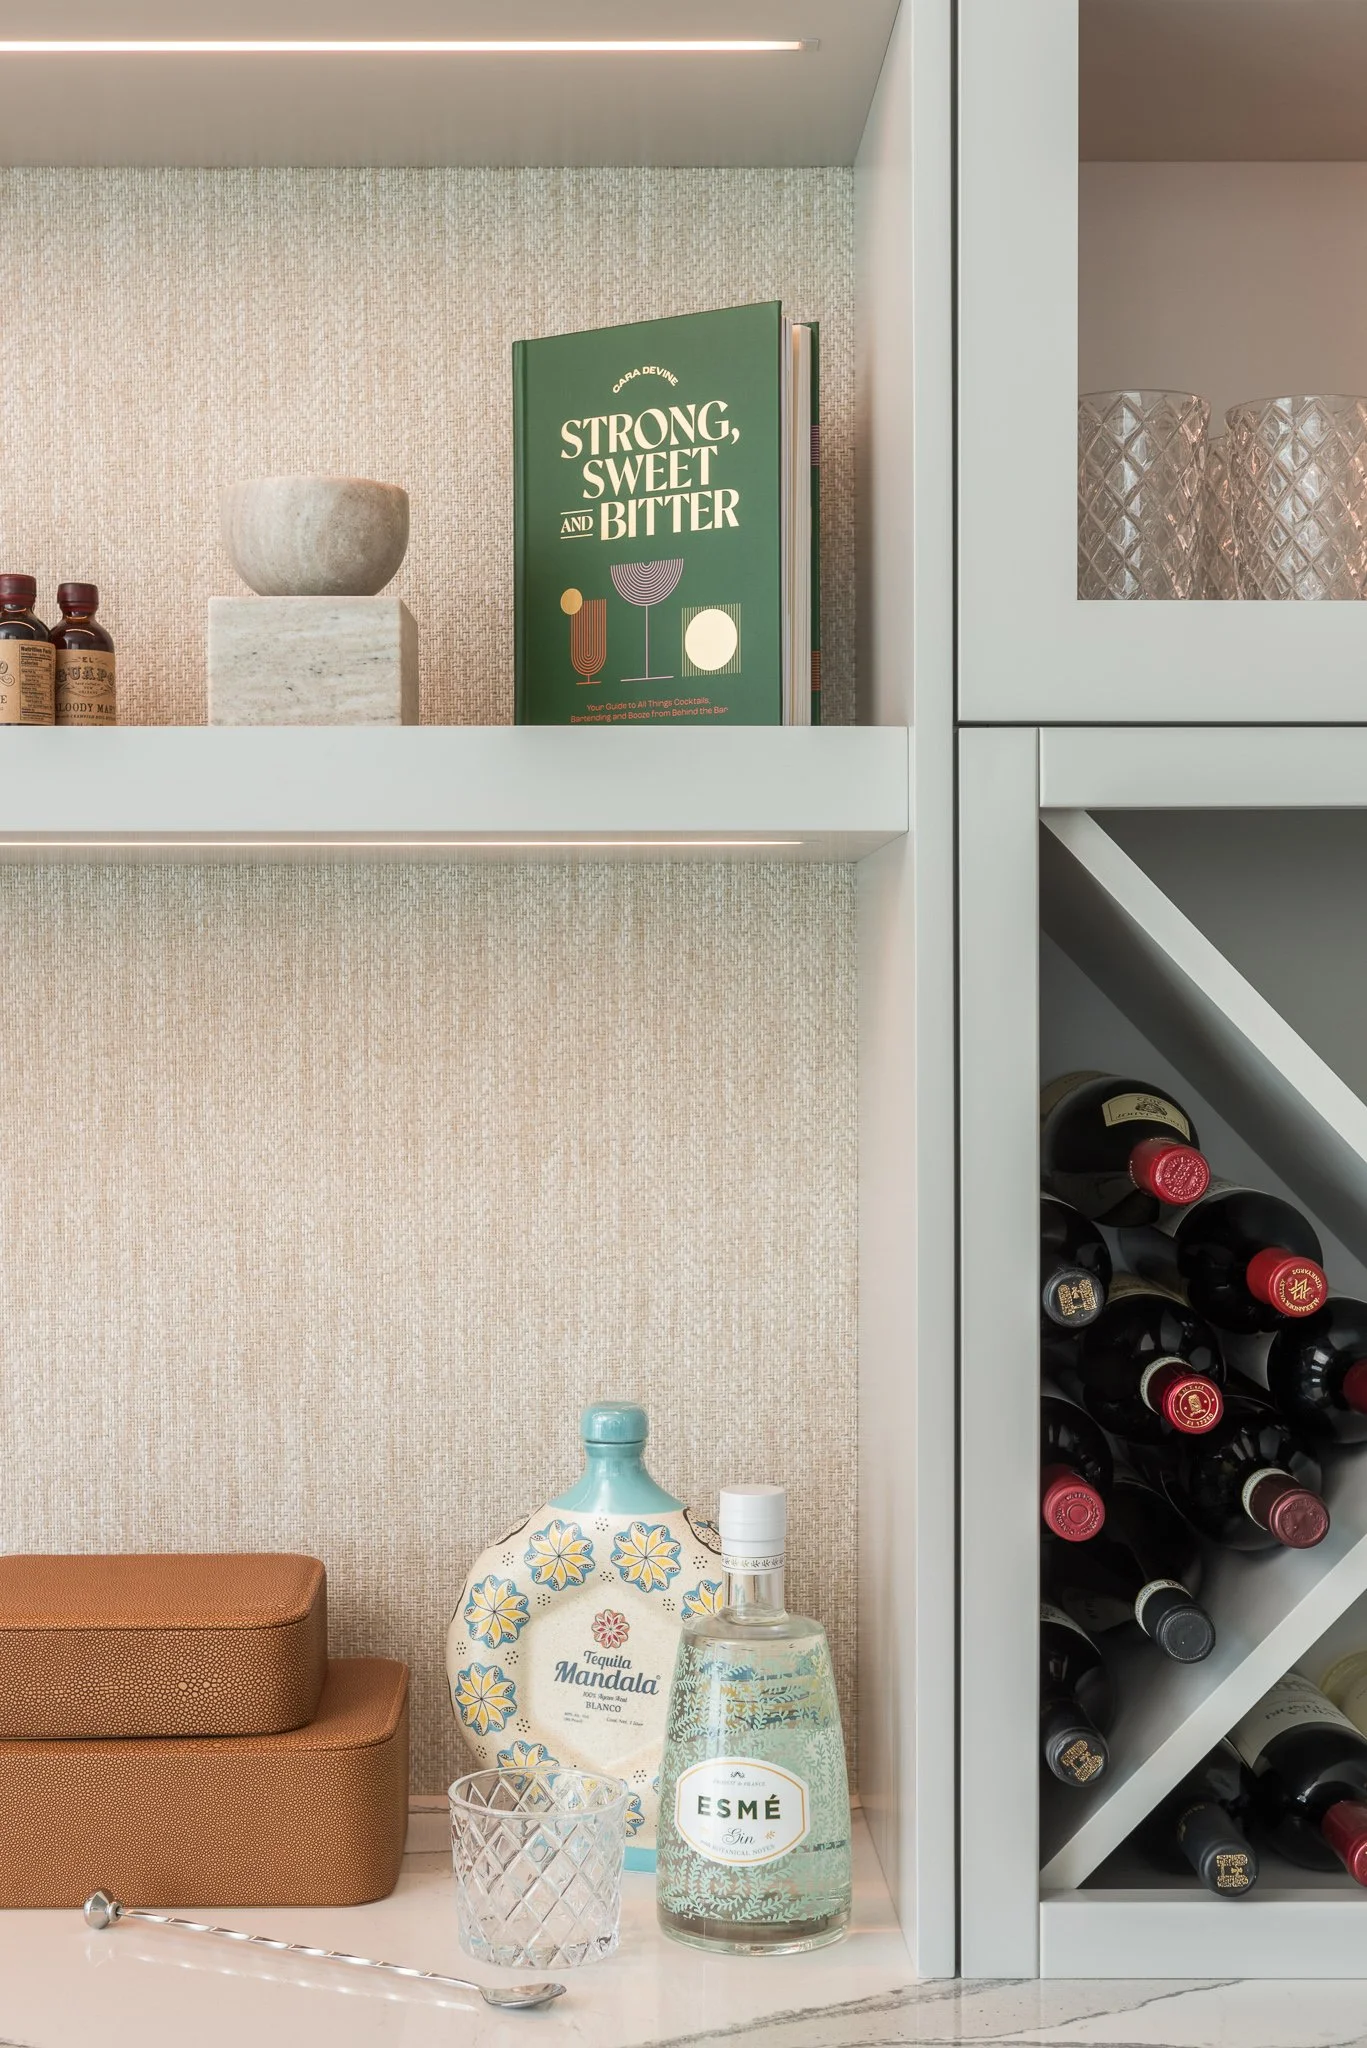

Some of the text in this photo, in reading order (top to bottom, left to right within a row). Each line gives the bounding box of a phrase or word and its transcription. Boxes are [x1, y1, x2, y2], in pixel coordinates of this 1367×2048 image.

[612, 366, 679, 394] CARA DEVINE
[560, 400, 741, 460] STRONG,
[582, 445, 718, 499] SWEET
[560, 488, 740, 541] AND BITTER
[56, 703, 93, 712] LOODY
[570, 713, 612, 724] Bartending
[613, 711, 627, 721] and
[628, 711, 650, 719] Booze
[651, 709, 671, 718] from
[672, 707, 697, 717] Behind
[699, 706, 712, 715] the
[586, 703, 604, 711] Your
[605, 701, 626, 711] Guide
[628, 701, 636, 709] to
[637, 699, 647, 708] All
[648, 699, 673, 709] Things
[583, 1650, 633, 1670] Tequila
[554, 1661, 659, 1695] Mandala
[585, 1701, 622, 1713] BLANCO
[697, 1793, 781, 1820] ESMÉ
[721, 1828, 756, 1846] Gin
[712, 1844, 750, 1857] BOTANICAL
[752, 1844, 776, 1856] NOTES
